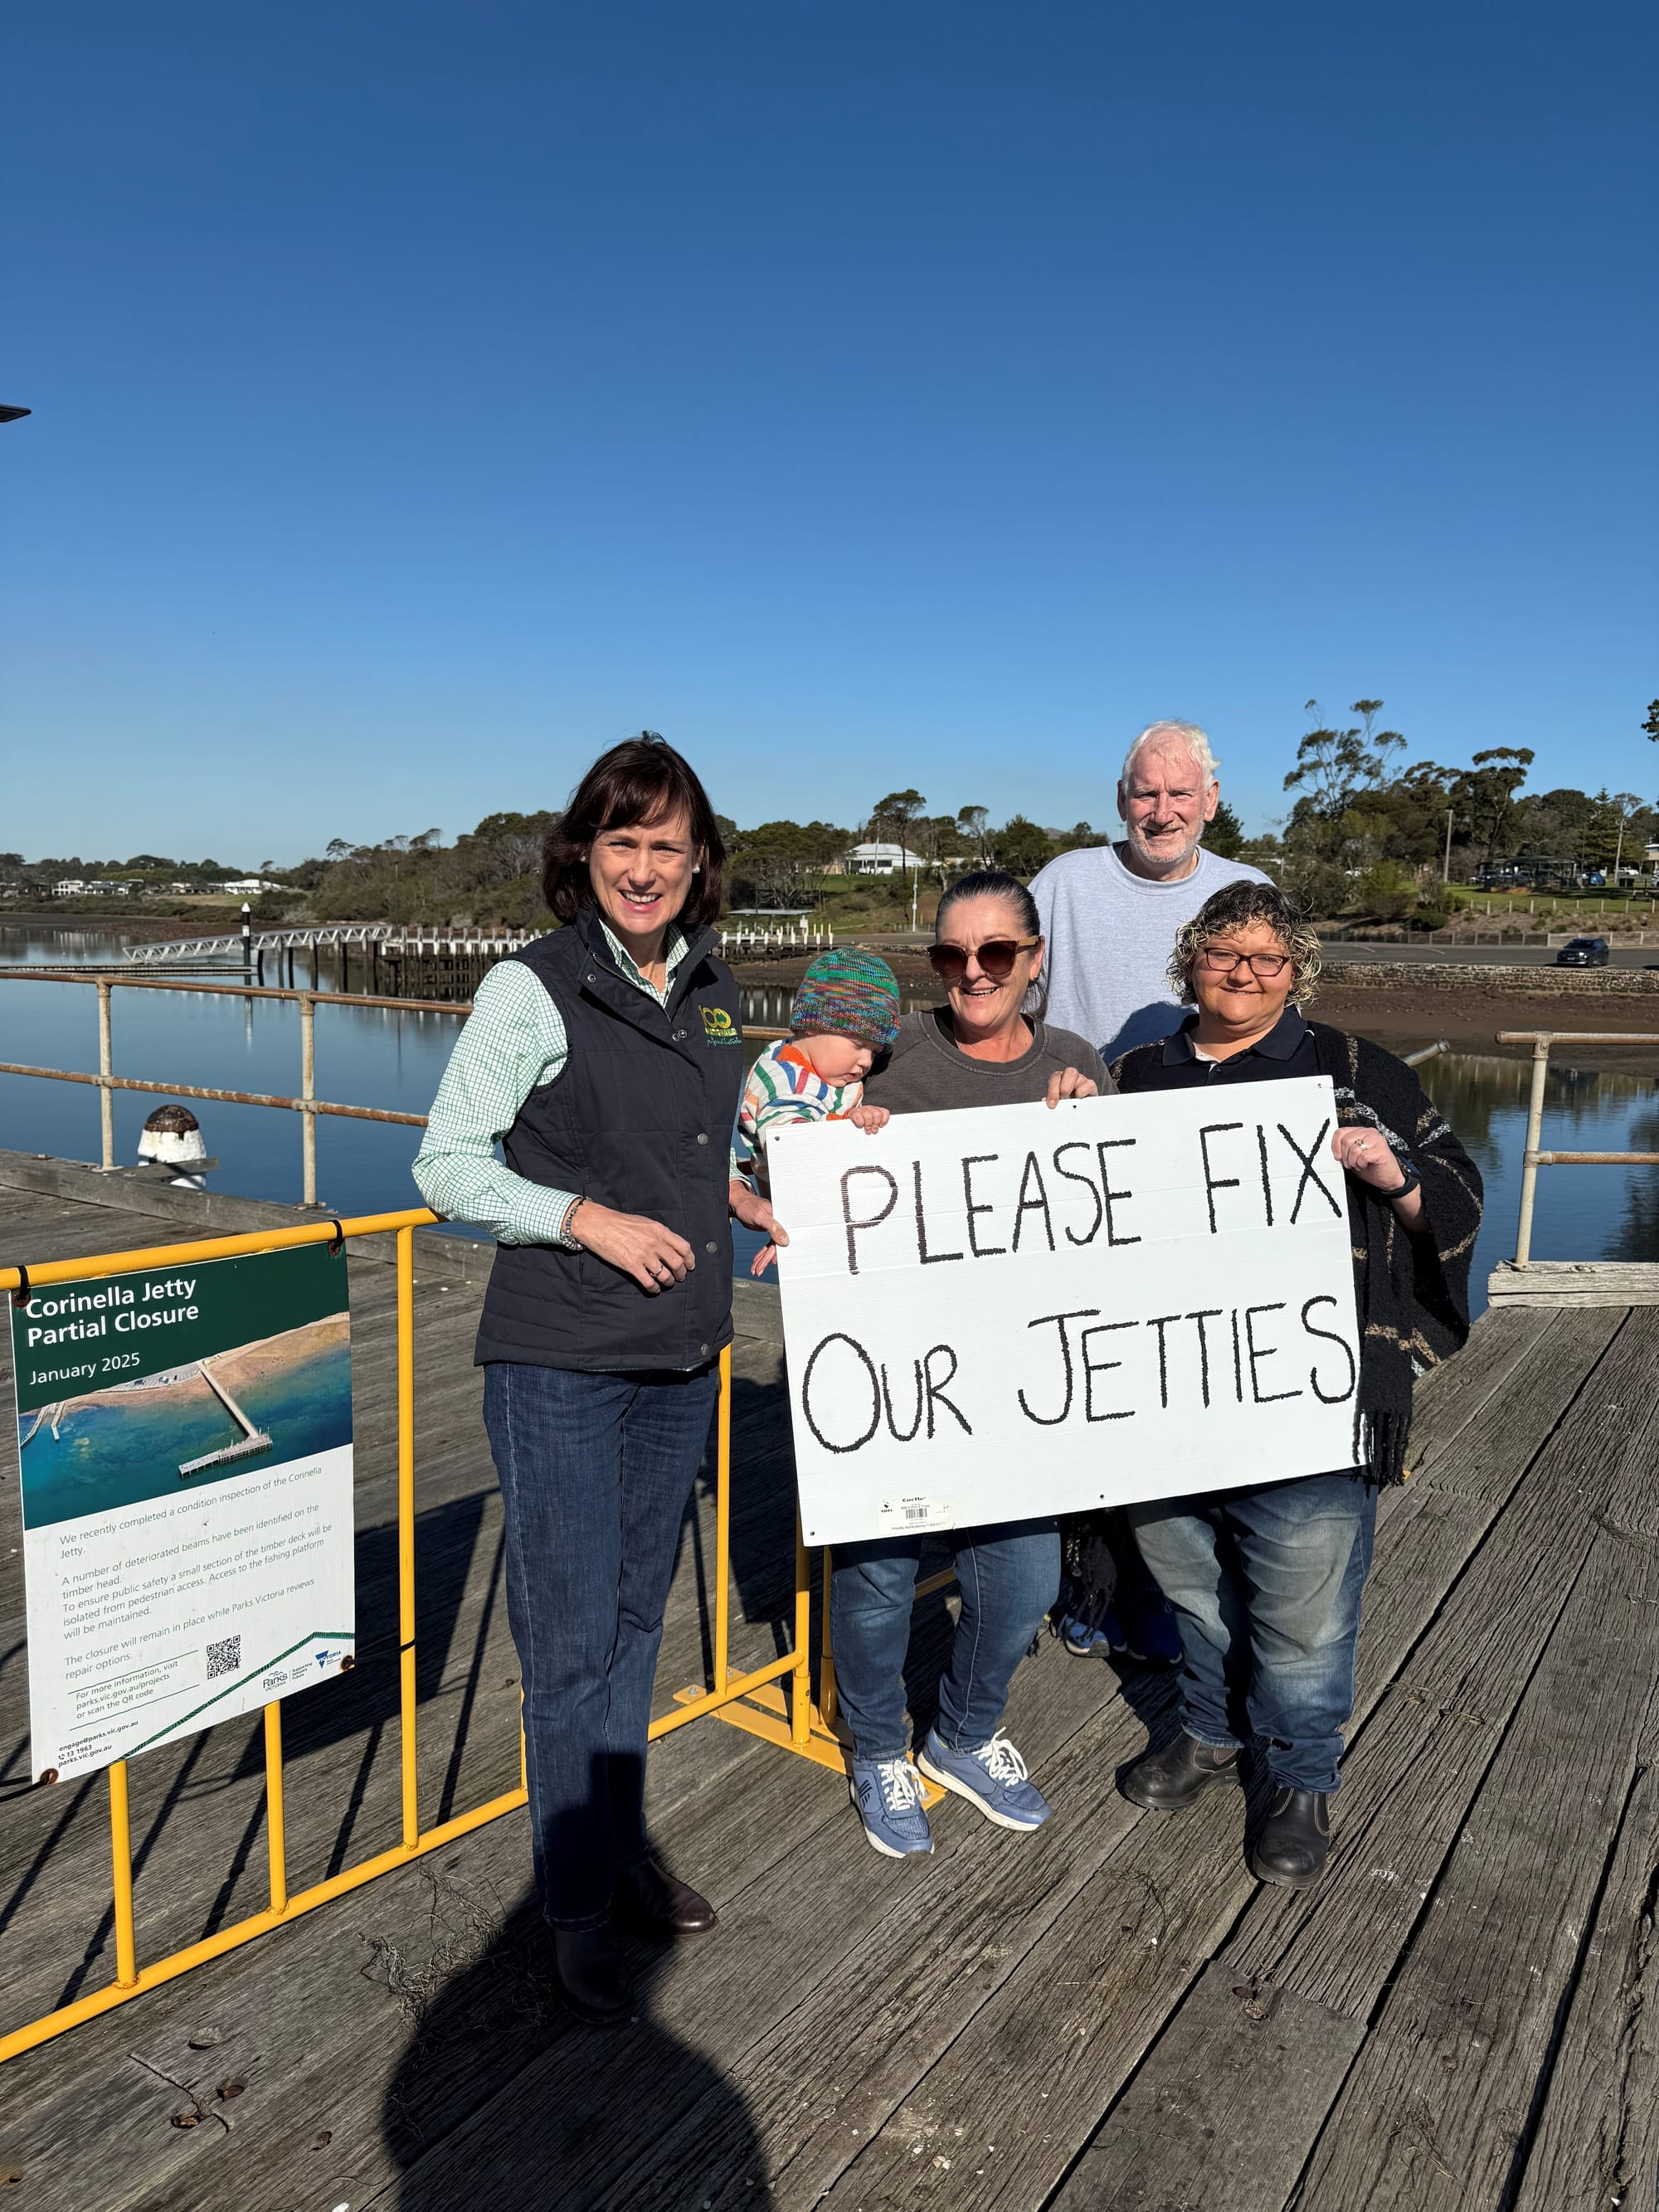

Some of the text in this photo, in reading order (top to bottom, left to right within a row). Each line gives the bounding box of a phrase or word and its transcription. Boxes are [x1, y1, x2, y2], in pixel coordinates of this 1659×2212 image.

[839, 1118, 1343, 1275] PLEASE FIX
[26, 1277, 197, 1320] Corinella Jetty
[27, 1304, 200, 1348] Partial Closure
[30, 1352, 141, 1385] January 2025
[802, 1296, 1356, 1453] OUR JETTIES
[59, 1534, 77, 1545] We
[80, 1523, 117, 1540] recently
[119, 1509, 167, 1529] completed
[177, 1497, 217, 1514] condition
[219, 1485, 260, 1502] inspection
[262, 1479, 271, 1490] of
[273, 1477, 287, 1487] the
[60, 1547, 85, 1559] Jetty.
[61, 1505, 319, 1586] A number of deteriorated beams have been identified on the
[62, 1603, 75, 1612] To
[77, 1593, 109, 1608] ensure
[112, 1584, 140, 1601] public
[142, 1576, 168, 1590] safety
[178, 1563, 201, 1578] small
[202, 1556, 232, 1572] section
[234, 1550, 243, 1561] of
[245, 1548, 259, 1558] the
[260, 1539, 286, 1553] timber
[288, 1532, 306, 1544] deck
[308, 1526, 320, 1538] will
[323, 1524, 332, 1533] be
[62, 1574, 122, 1599] timber head.
[63, 1607, 100, 1626] isolated
[103, 1602, 125, 1615] from
[128, 1587, 174, 1609] pedestrian
[208, 1568, 236, 1582] Access
[238, 1564, 247, 1573] to
[249, 1559, 263, 1569] the
[265, 1550, 290, 1564] fishing
[292, 1539, 324, 1557] platform
[63, 1605, 152, 1640] will be maintained.
[64, 1578, 314, 1666] The closure will remain in place while Parks Victoria reviews
[66, 1653, 133, 1680] repair options.
[75, 1660, 178, 1700] For more information, visit
[263, 1673, 288, 1689] Parks
[76, 1688, 153, 1719] or scan the QR code
[59, 1720, 139, 1752] engage@parks.vic.gov.au
[76, 1744, 92, 1754] 1963
[58, 1744, 112, 1768] parks.vic.gov.au
